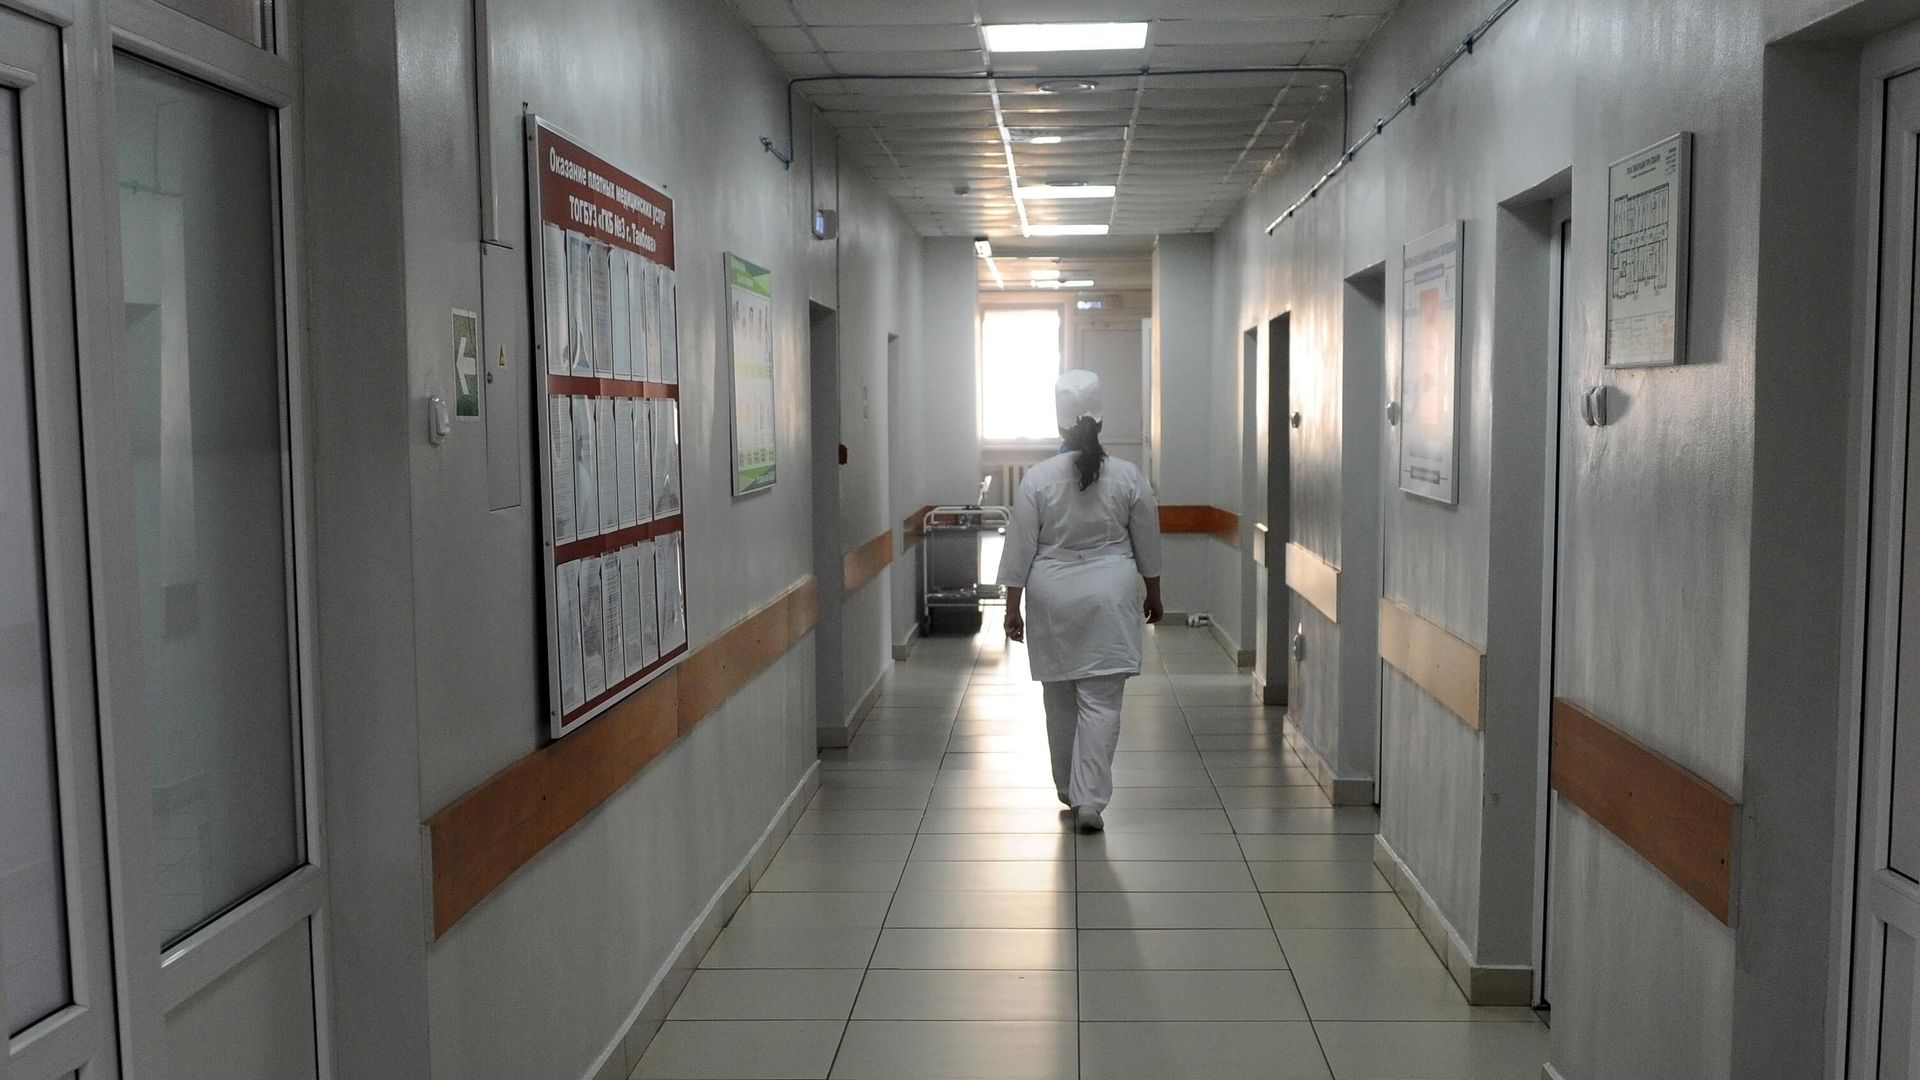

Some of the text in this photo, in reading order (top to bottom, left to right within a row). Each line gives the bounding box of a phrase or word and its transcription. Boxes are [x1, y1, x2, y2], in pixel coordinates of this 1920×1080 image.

[550, 146, 666, 230] Оказание платных медицинских услуг
[569, 195, 597, 229] ТОГБУЗ
[614, 214, 625, 240] №3
[626, 226, 632, 244] г.
[631, 222, 656, 252] Тамбова»
